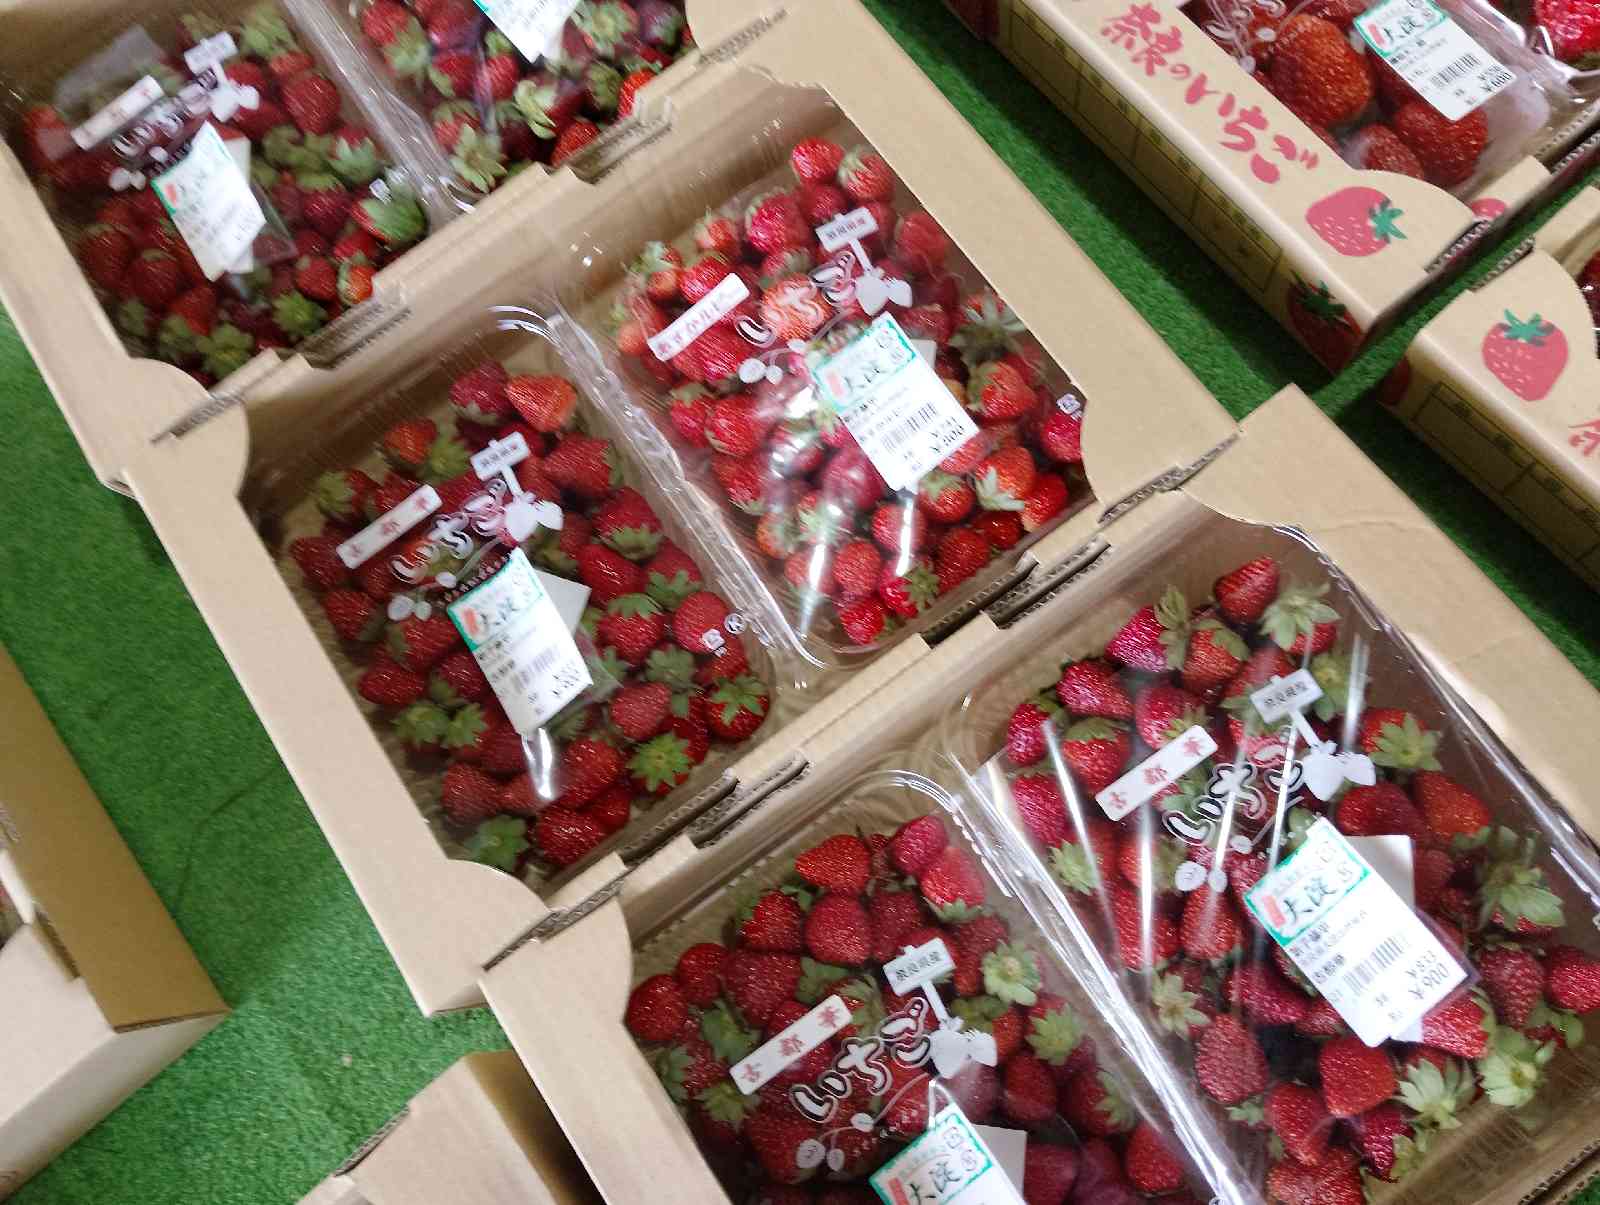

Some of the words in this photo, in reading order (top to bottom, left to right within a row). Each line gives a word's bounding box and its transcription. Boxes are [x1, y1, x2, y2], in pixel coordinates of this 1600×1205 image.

[1101, 4, 1318, 184] 奈良のいちご
[734, 250, 857, 348] いちご
[389, 478, 508, 584] いちご
[1161, 736, 1304, 846] いちご
[789, 997, 932, 1123] いちご
